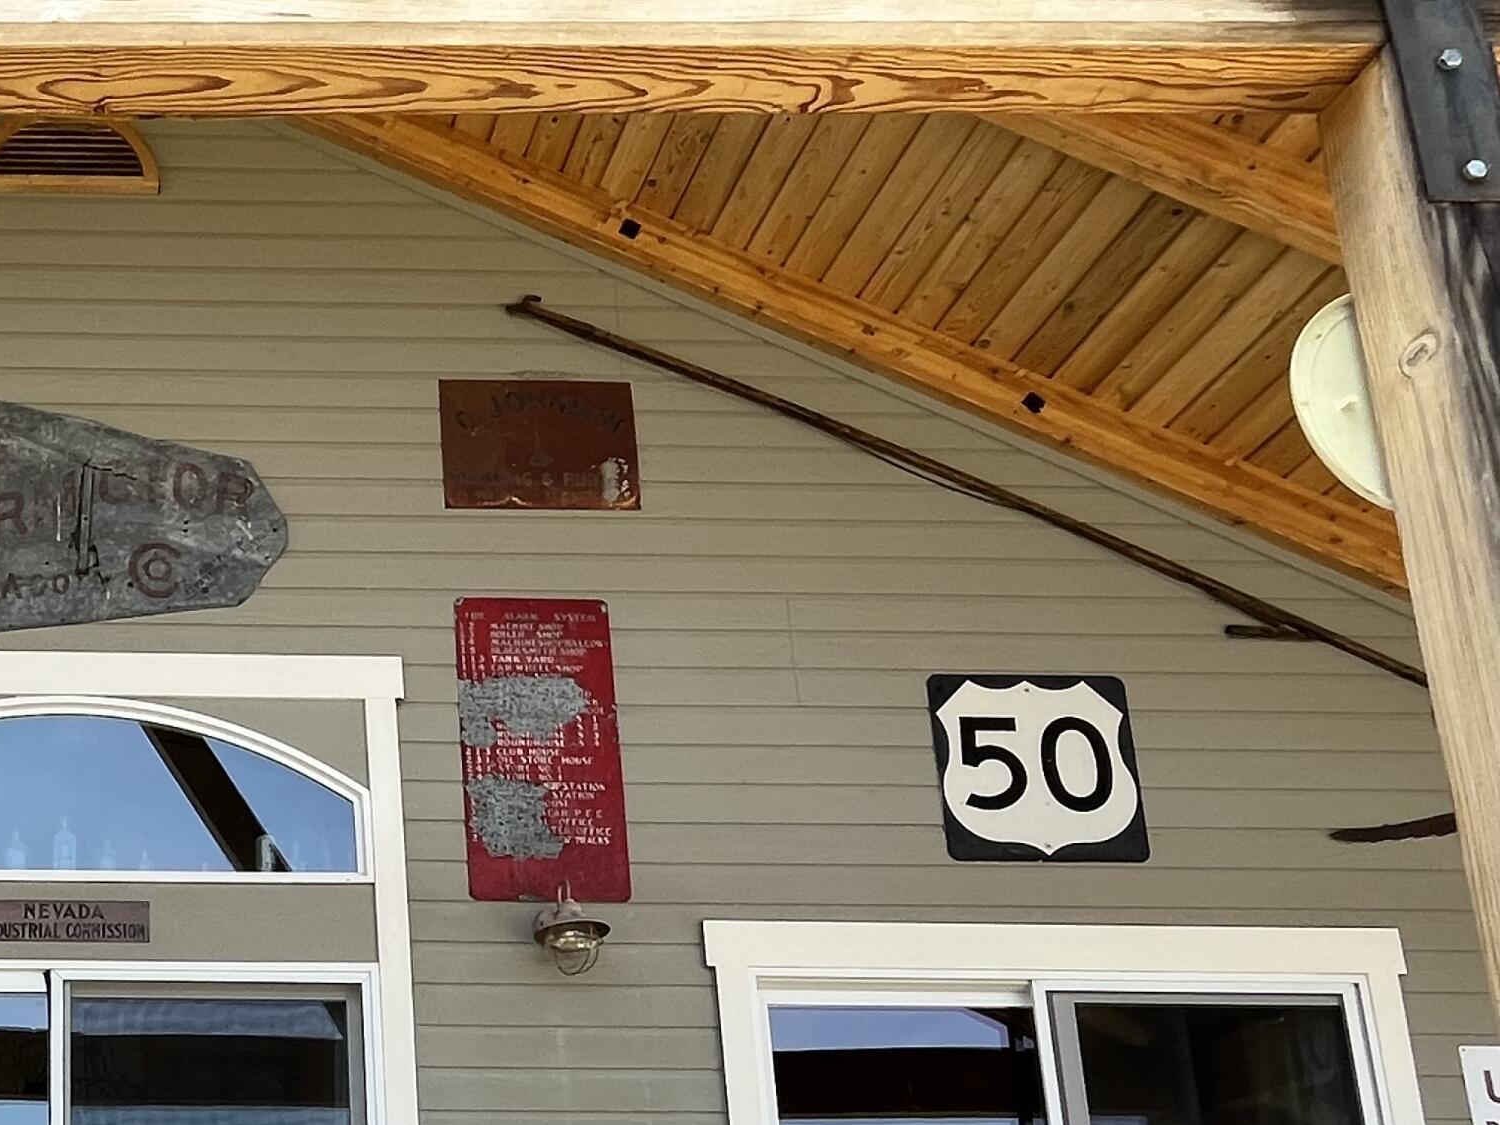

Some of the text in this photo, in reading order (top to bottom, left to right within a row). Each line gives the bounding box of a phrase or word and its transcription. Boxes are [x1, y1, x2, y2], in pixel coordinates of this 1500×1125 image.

[491, 655, 521, 663] TANK
[525, 655, 555, 663] YARD
[959, 716, 1113, 812] 50
[551, 791, 595, 800] STATION
[23, 903, 105, 920] NEVADA
[65, 921, 146, 939] COMMISSION
